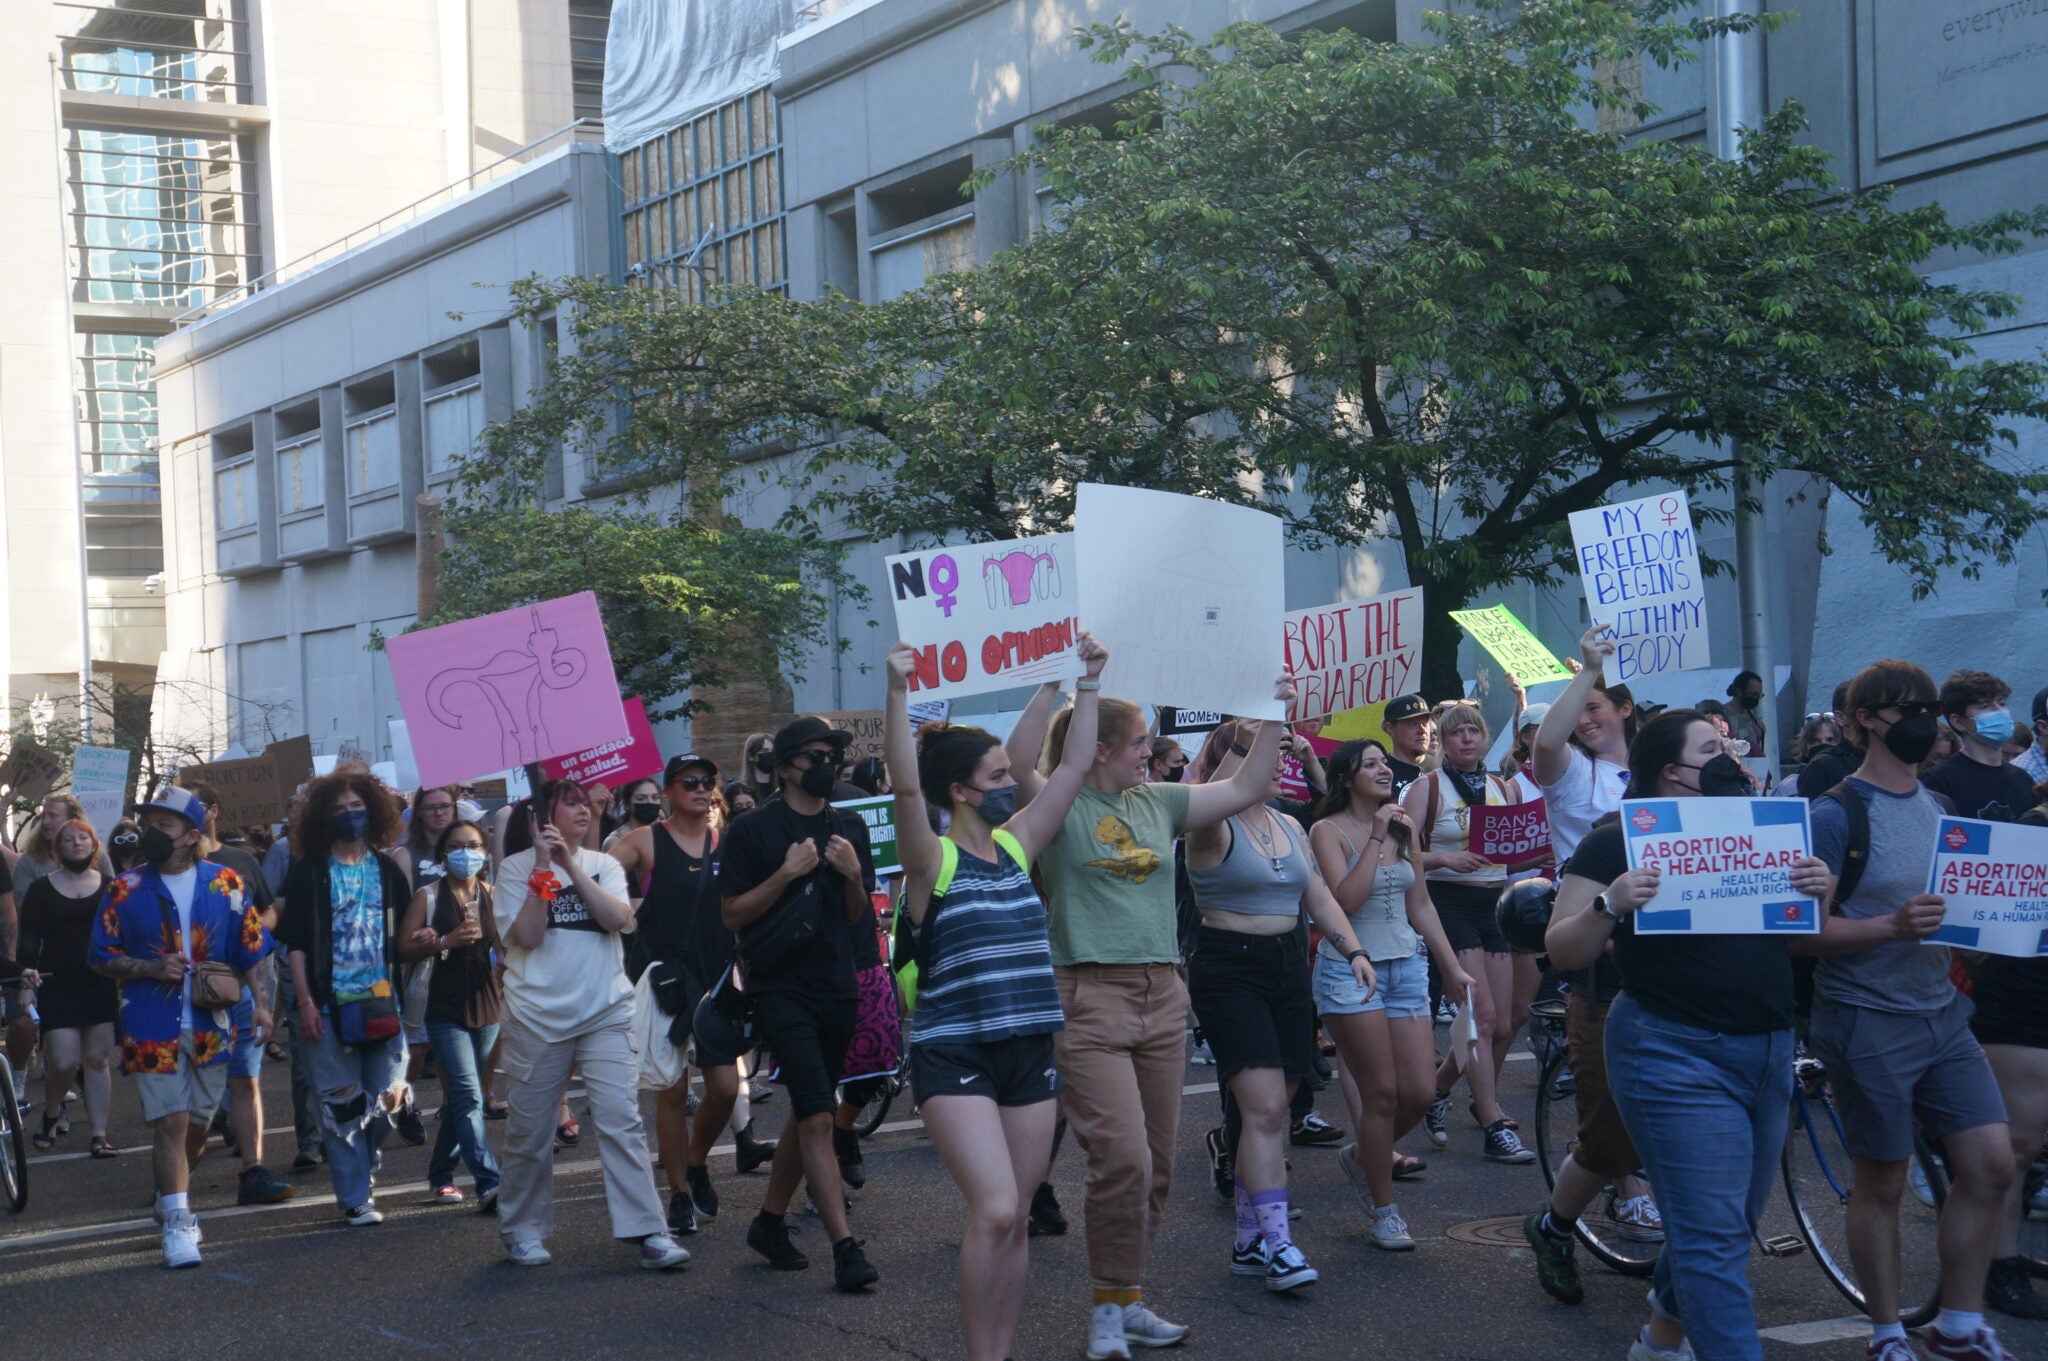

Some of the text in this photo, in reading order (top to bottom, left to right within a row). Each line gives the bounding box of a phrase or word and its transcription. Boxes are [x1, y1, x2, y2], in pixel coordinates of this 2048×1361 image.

[1602, 503, 1645, 538] MY
[1581, 528, 1693, 575] FREEDOM
[1595, 559, 1691, 605] BEGINS
[1456, 608, 1509, 628] MAKE
[1284, 607, 1352, 676] BORT
[1358, 595, 1414, 659] THE
[1492, 640, 1541, 661] TION
[1618, 633, 1686, 681] BODY
[906, 640, 968, 692] NO
[1510, 657, 1562, 679] SAFE
[1290, 649, 1416, 721] TRIARCHY
[1176, 710, 1221, 724] WOMEN
[849, 717, 885, 740] YOUR
[560, 735, 635, 770] un cuidado
[565, 752, 626, 781] de salud.
[879, 807, 888, 825] IS
[1484, 811, 1537, 829] BANS
[869, 824, 896, 844] RIGHT!
[1483, 820, 1552, 842] OFF OU
[1641, 834, 1753, 860] ABORTION
[1642, 860, 1661, 873] IS
[1942, 860, 2047, 880] ABORTION
[1721, 871, 1793, 886] HEALTHCA
[1940, 878, 1959, 894] IS
[1681, 883, 1793, 901] IS A HUMAN RIGH
[551, 903, 573, 914] OFF
[554, 911, 590, 923] BODIE
[1973, 910, 1985, 920] IS
[1989, 911, 1998, 921] A
[2003, 911, 2041, 922] HUMAN
